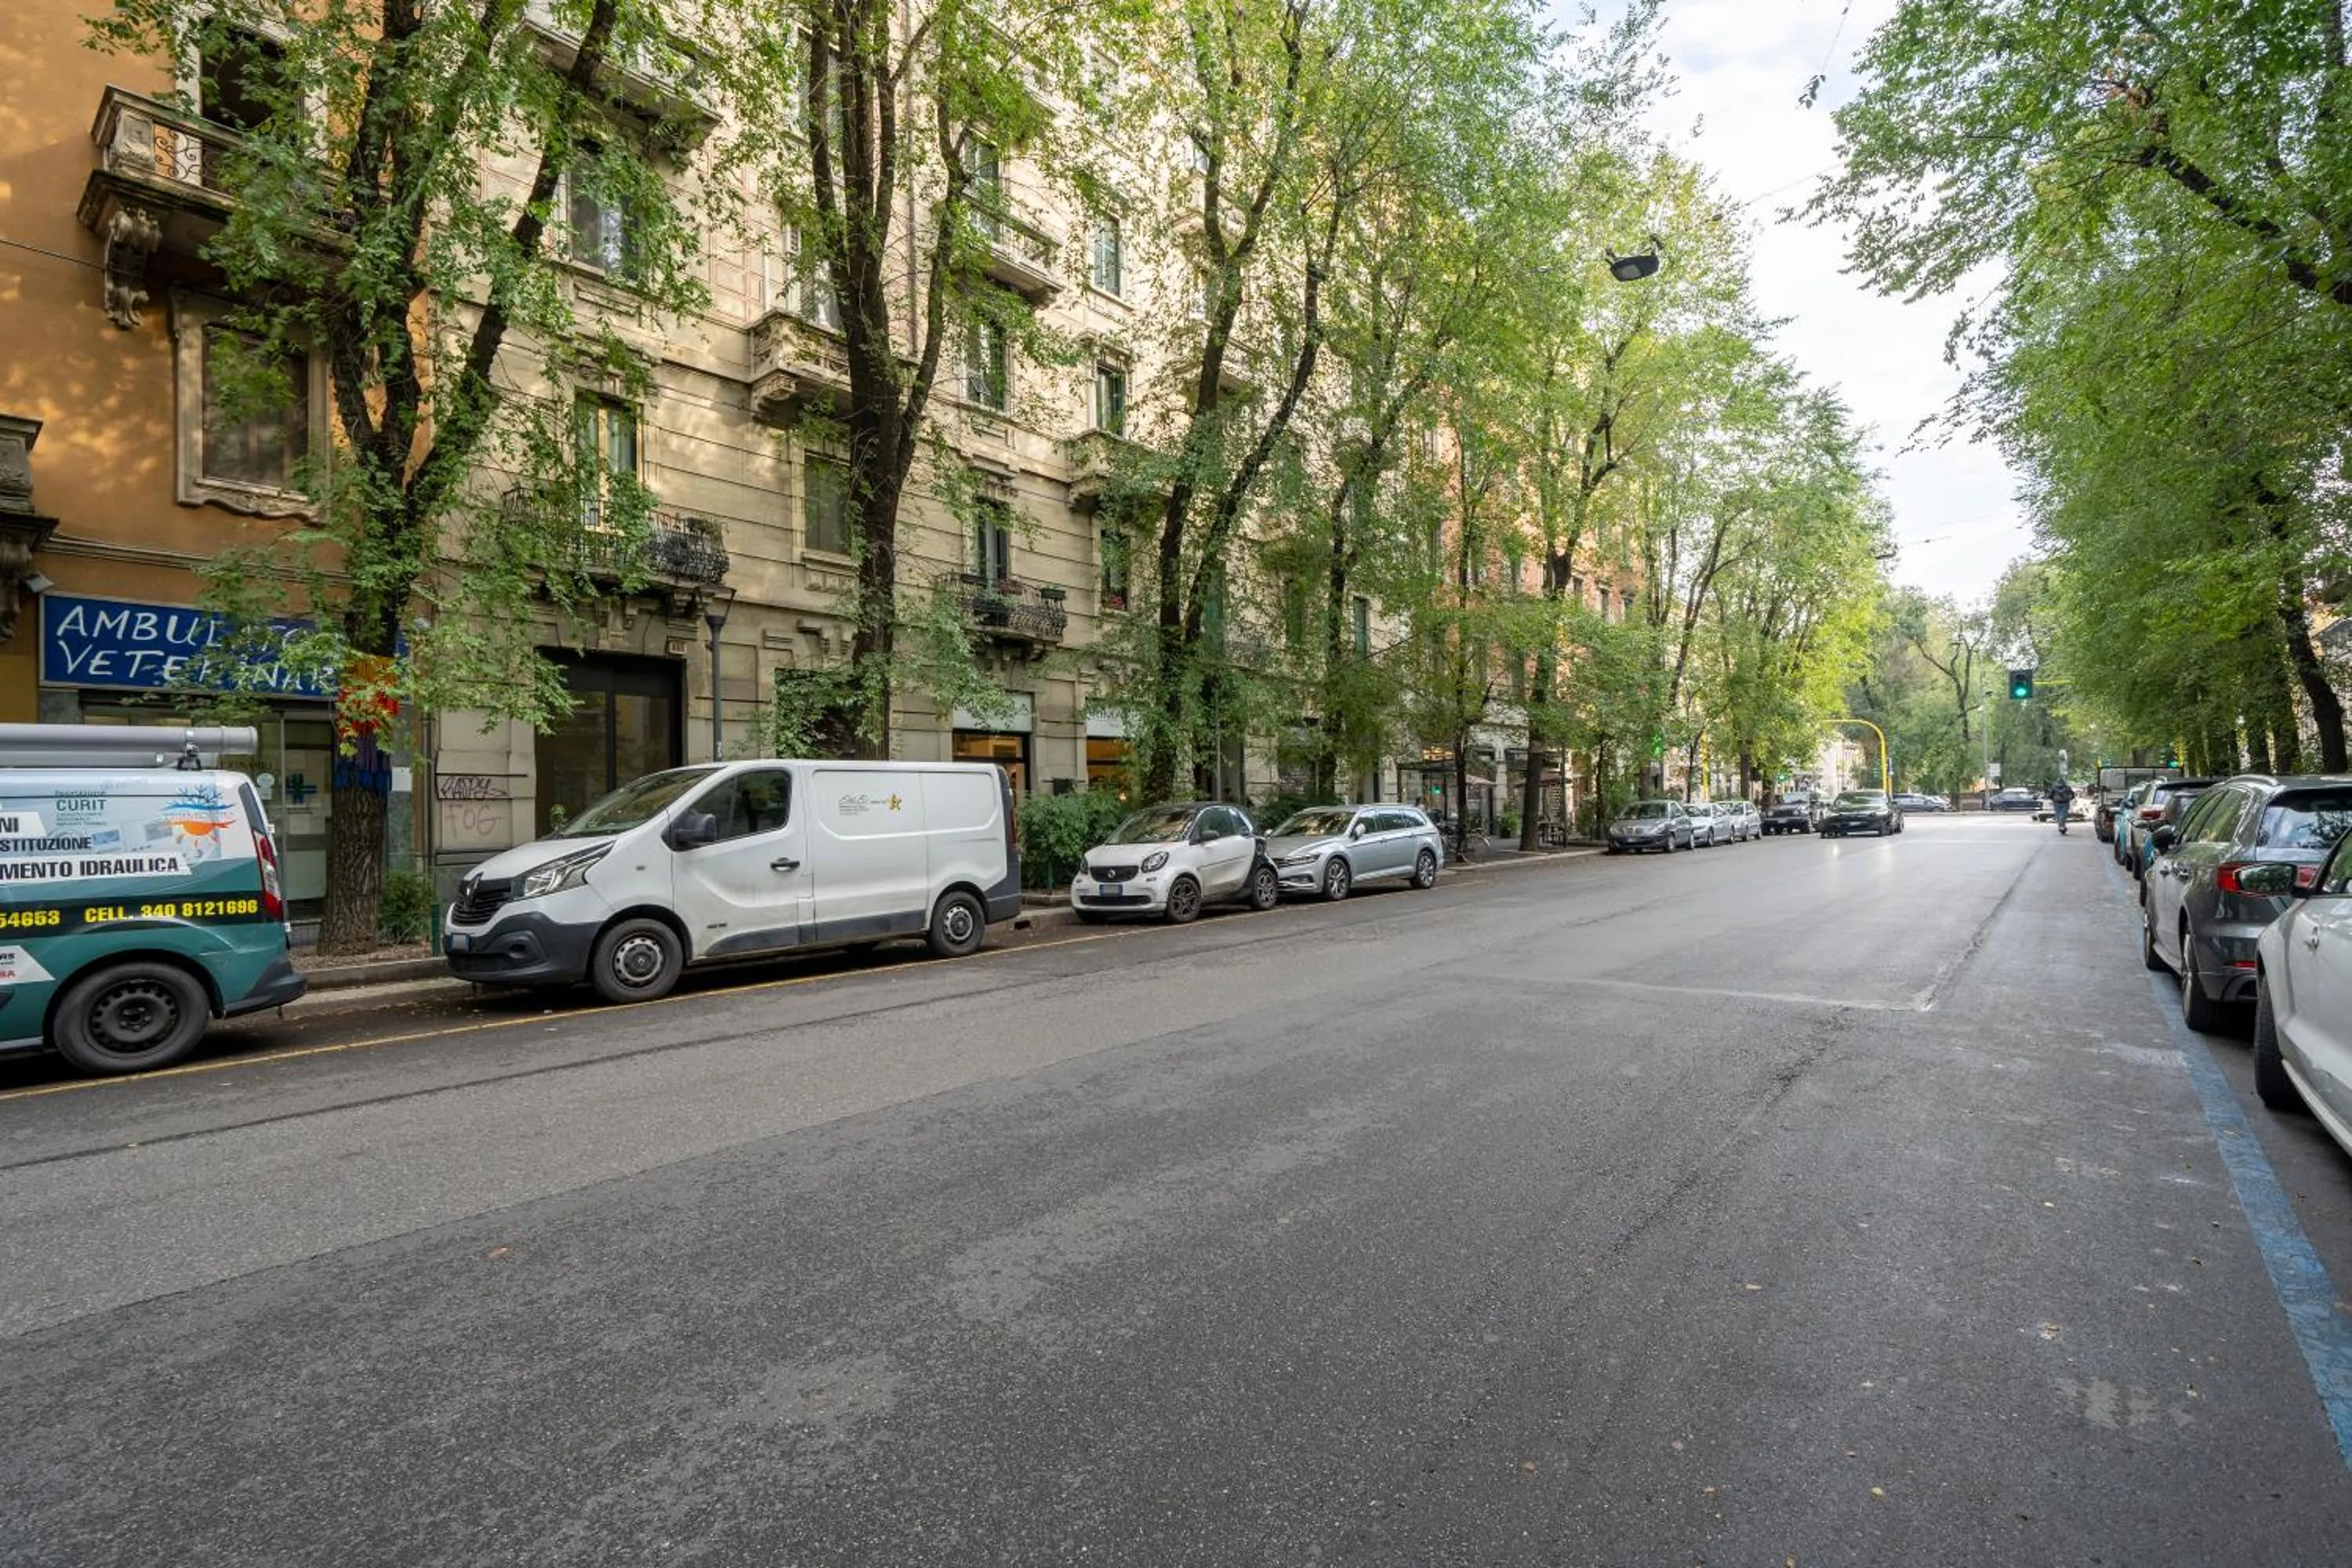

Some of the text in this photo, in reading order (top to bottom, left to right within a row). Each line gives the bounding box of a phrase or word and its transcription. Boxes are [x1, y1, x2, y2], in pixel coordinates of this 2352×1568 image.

[56, 799, 107, 811] CURIT
[0, 837, 92, 852] STITUZIONE
[0, 858, 179, 880] MENTO IDRAULICA
[84, 906, 134, 923] CELL.
[140, 903, 176, 917] 340
